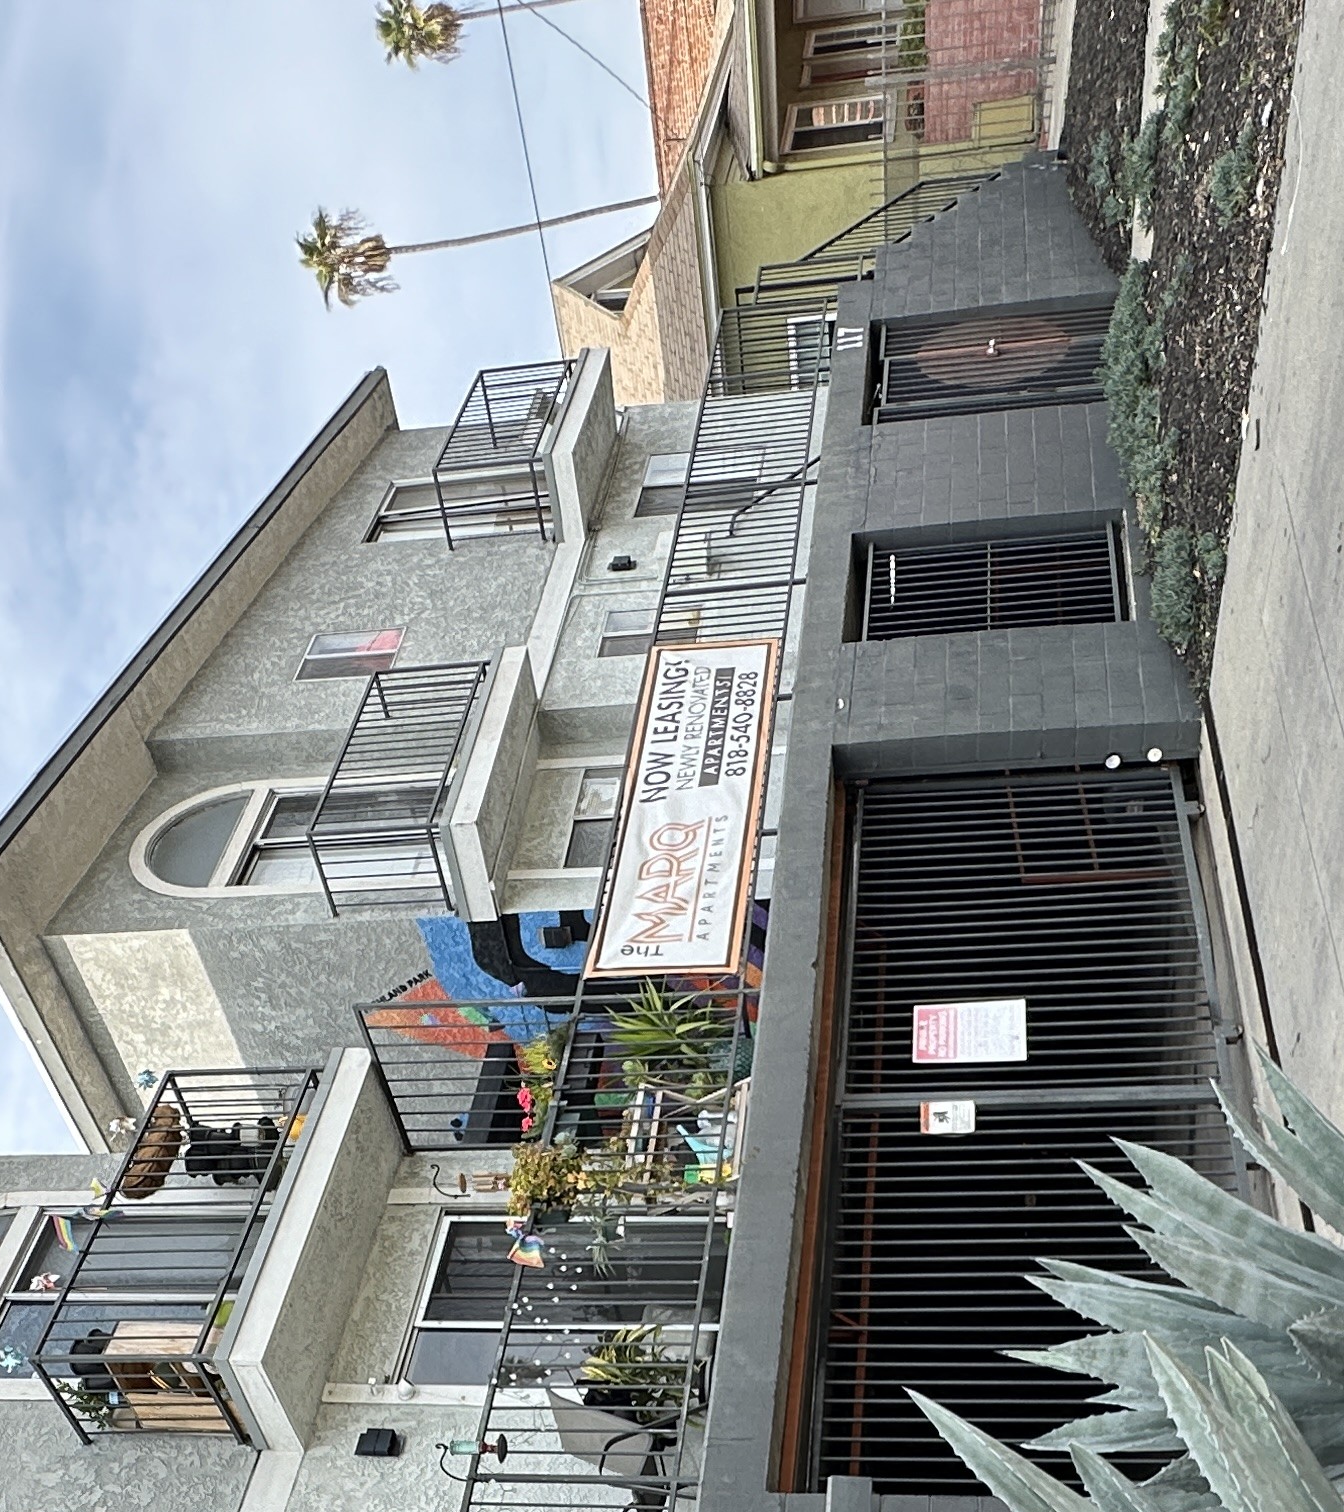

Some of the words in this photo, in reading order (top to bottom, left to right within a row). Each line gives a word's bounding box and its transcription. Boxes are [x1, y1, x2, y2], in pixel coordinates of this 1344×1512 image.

[836, 327, 864, 351] 117
[650, 659, 691, 744] LEASING!
[683, 666, 712, 740] RENOVATED
[724, 671, 759, 777] 818-540-8828
[638, 752, 675, 804] NOW
[674, 744, 700, 791] NEWLY
[625, 820, 705, 944] MARQ
[696, 814, 728, 941] APARTMENTS
[407, 969, 432, 988] PARK
[620, 944, 664, 957] The
